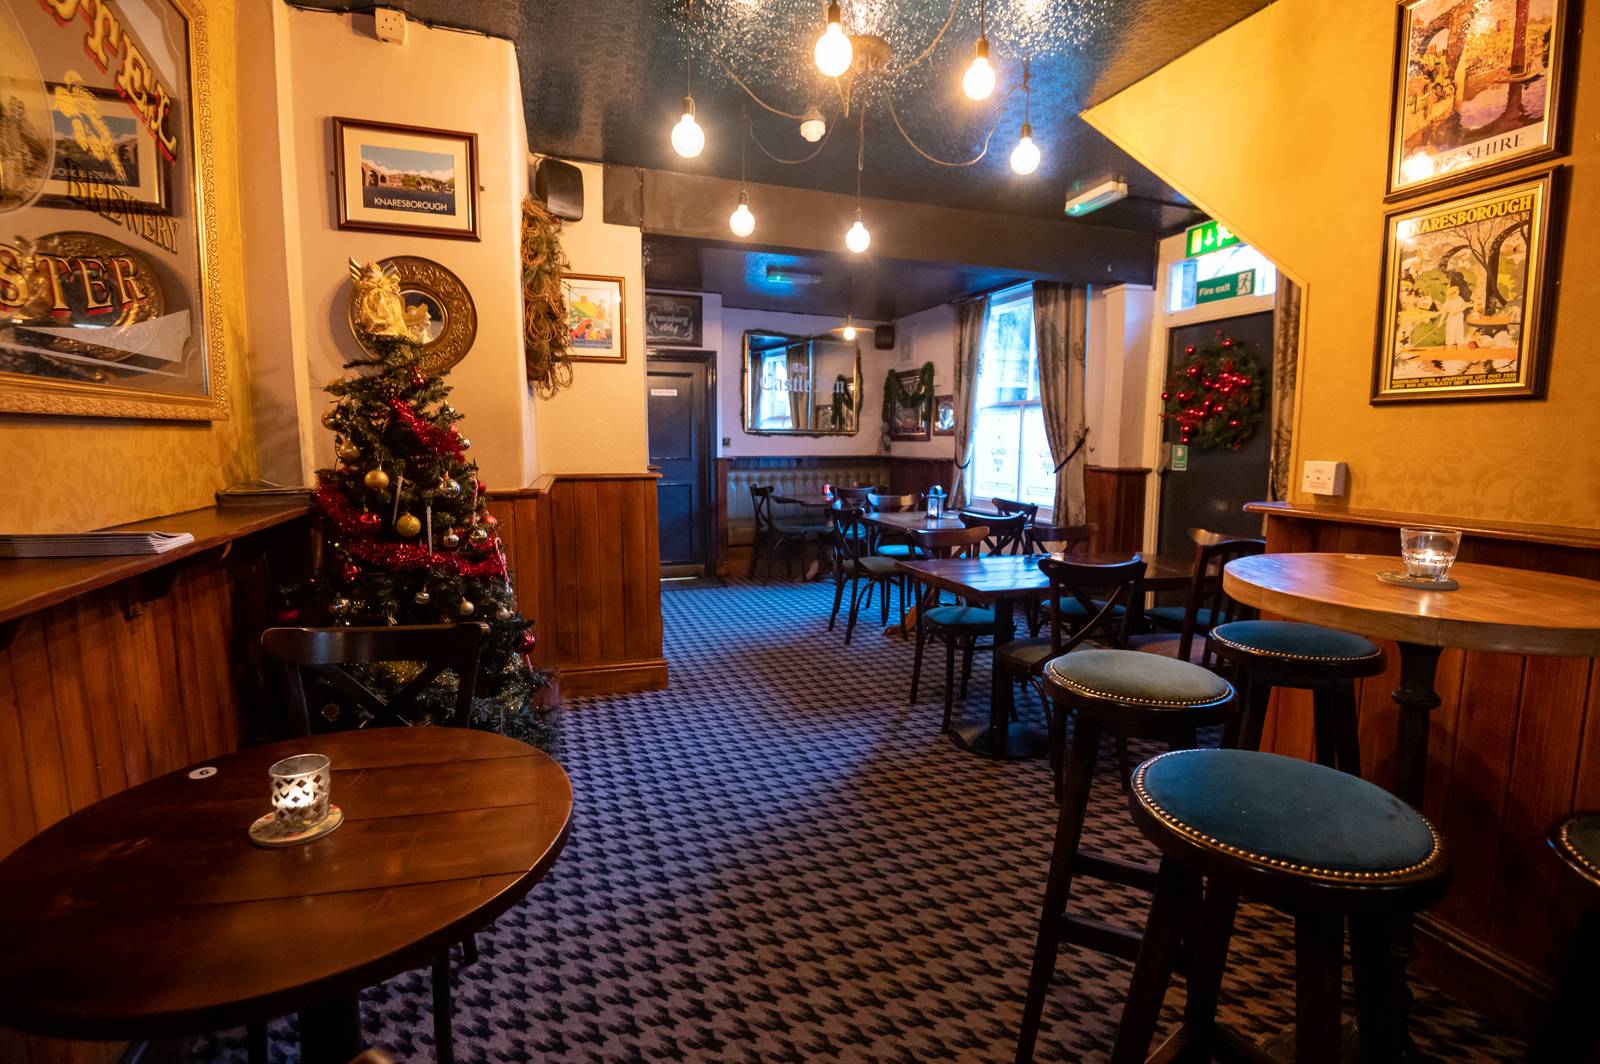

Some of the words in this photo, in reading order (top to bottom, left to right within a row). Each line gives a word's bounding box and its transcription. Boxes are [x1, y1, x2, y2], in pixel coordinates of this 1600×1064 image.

[65, 158, 179, 255] BREWERY
[374, 197, 448, 212] KNARESBOROUGH
[1199, 287, 1215, 297] Fire
[1215, 282, 1231, 293] exit
[760, 375, 811, 393] Castle
